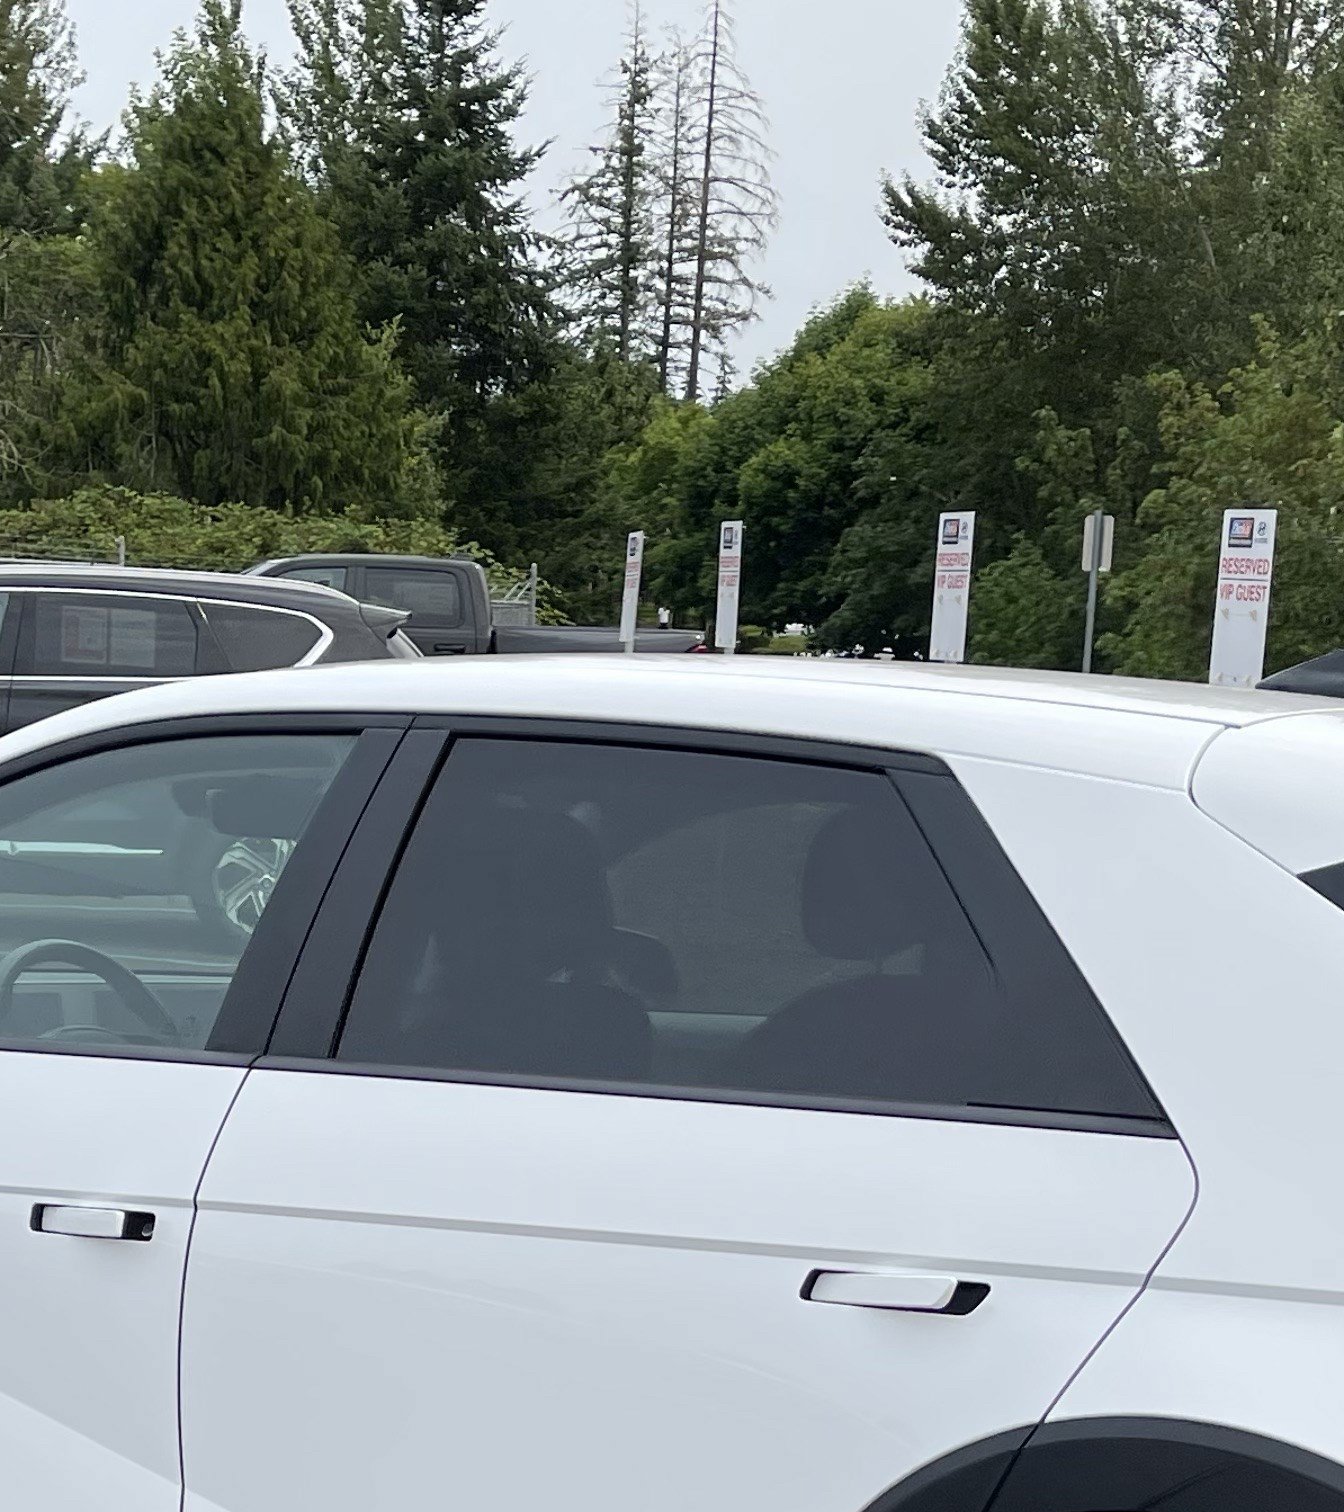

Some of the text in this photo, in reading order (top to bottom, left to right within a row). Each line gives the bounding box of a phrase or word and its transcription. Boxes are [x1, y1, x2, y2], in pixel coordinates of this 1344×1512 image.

[1220, 557, 1270, 575] RESERVED
[1219, 583, 1267, 601] VIP GUEST
